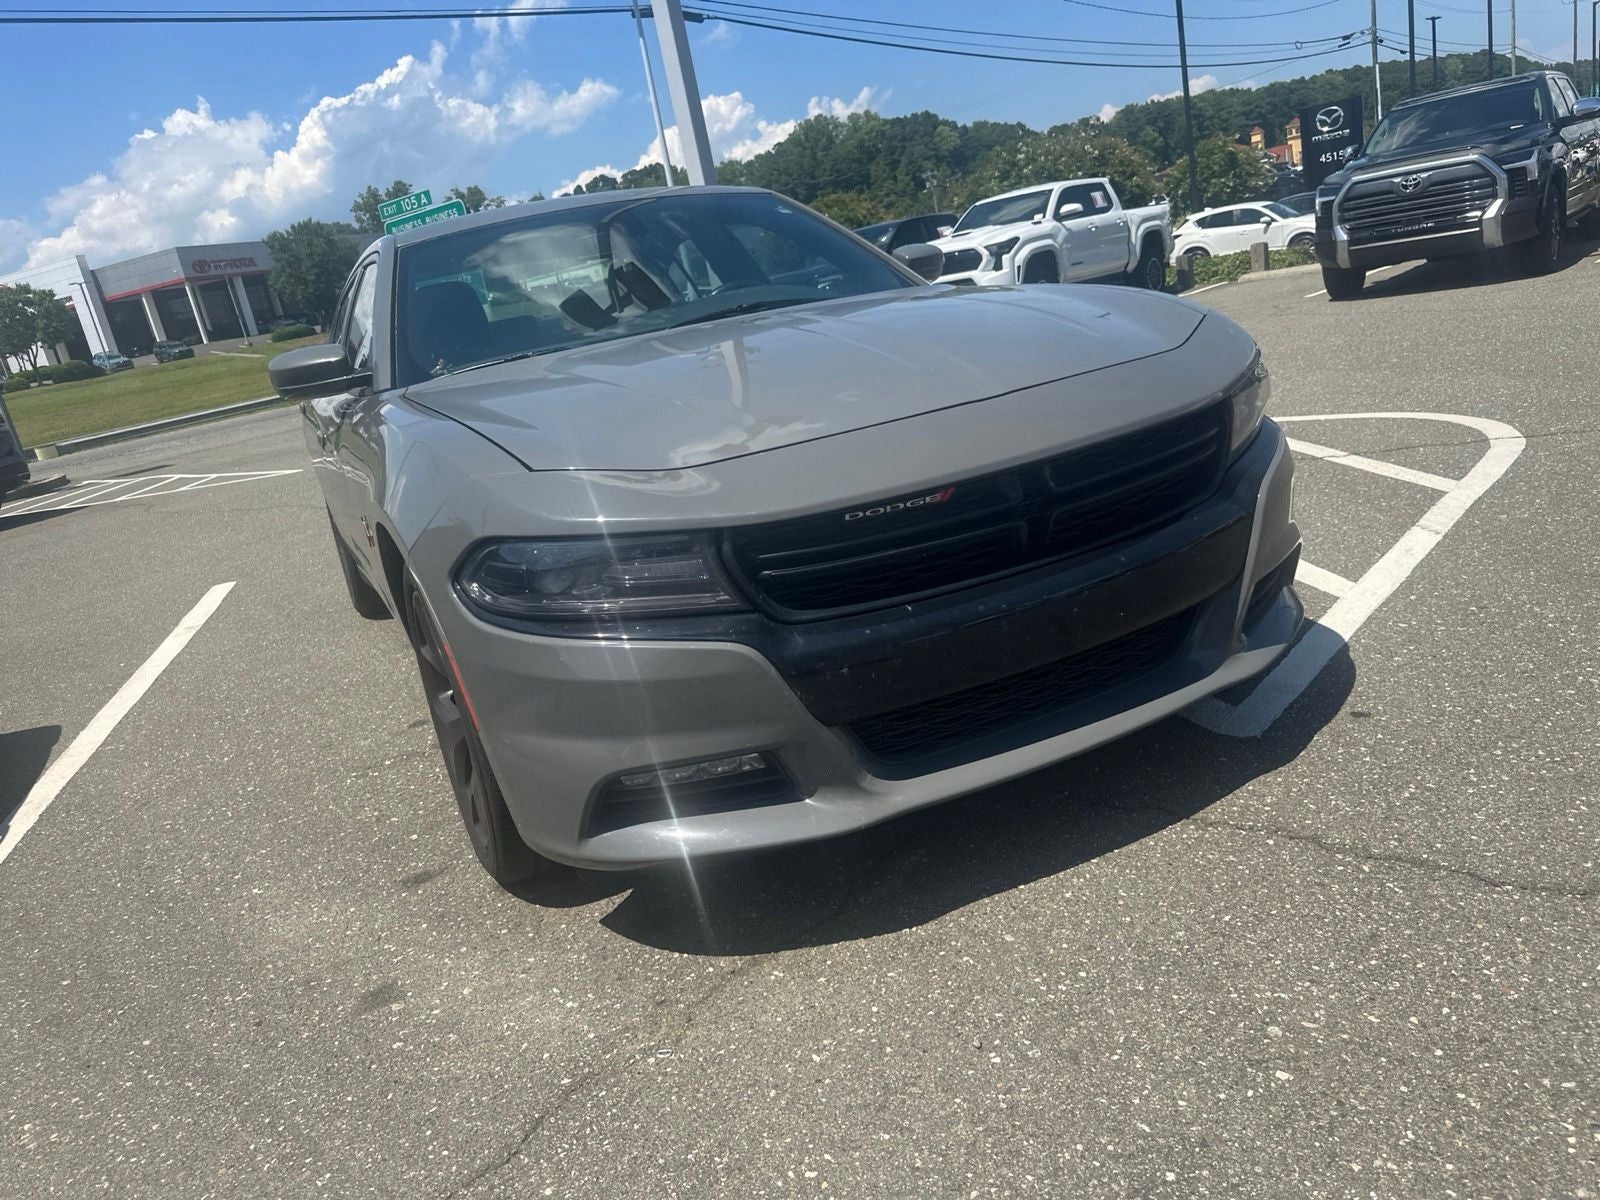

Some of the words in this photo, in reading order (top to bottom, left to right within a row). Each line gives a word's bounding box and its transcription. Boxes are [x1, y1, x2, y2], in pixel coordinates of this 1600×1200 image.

[383, 205, 397, 216] EXIT
[401, 198, 418, 212] 105
[420, 194, 428, 205] A
[844, 490, 945, 521] DODGE
